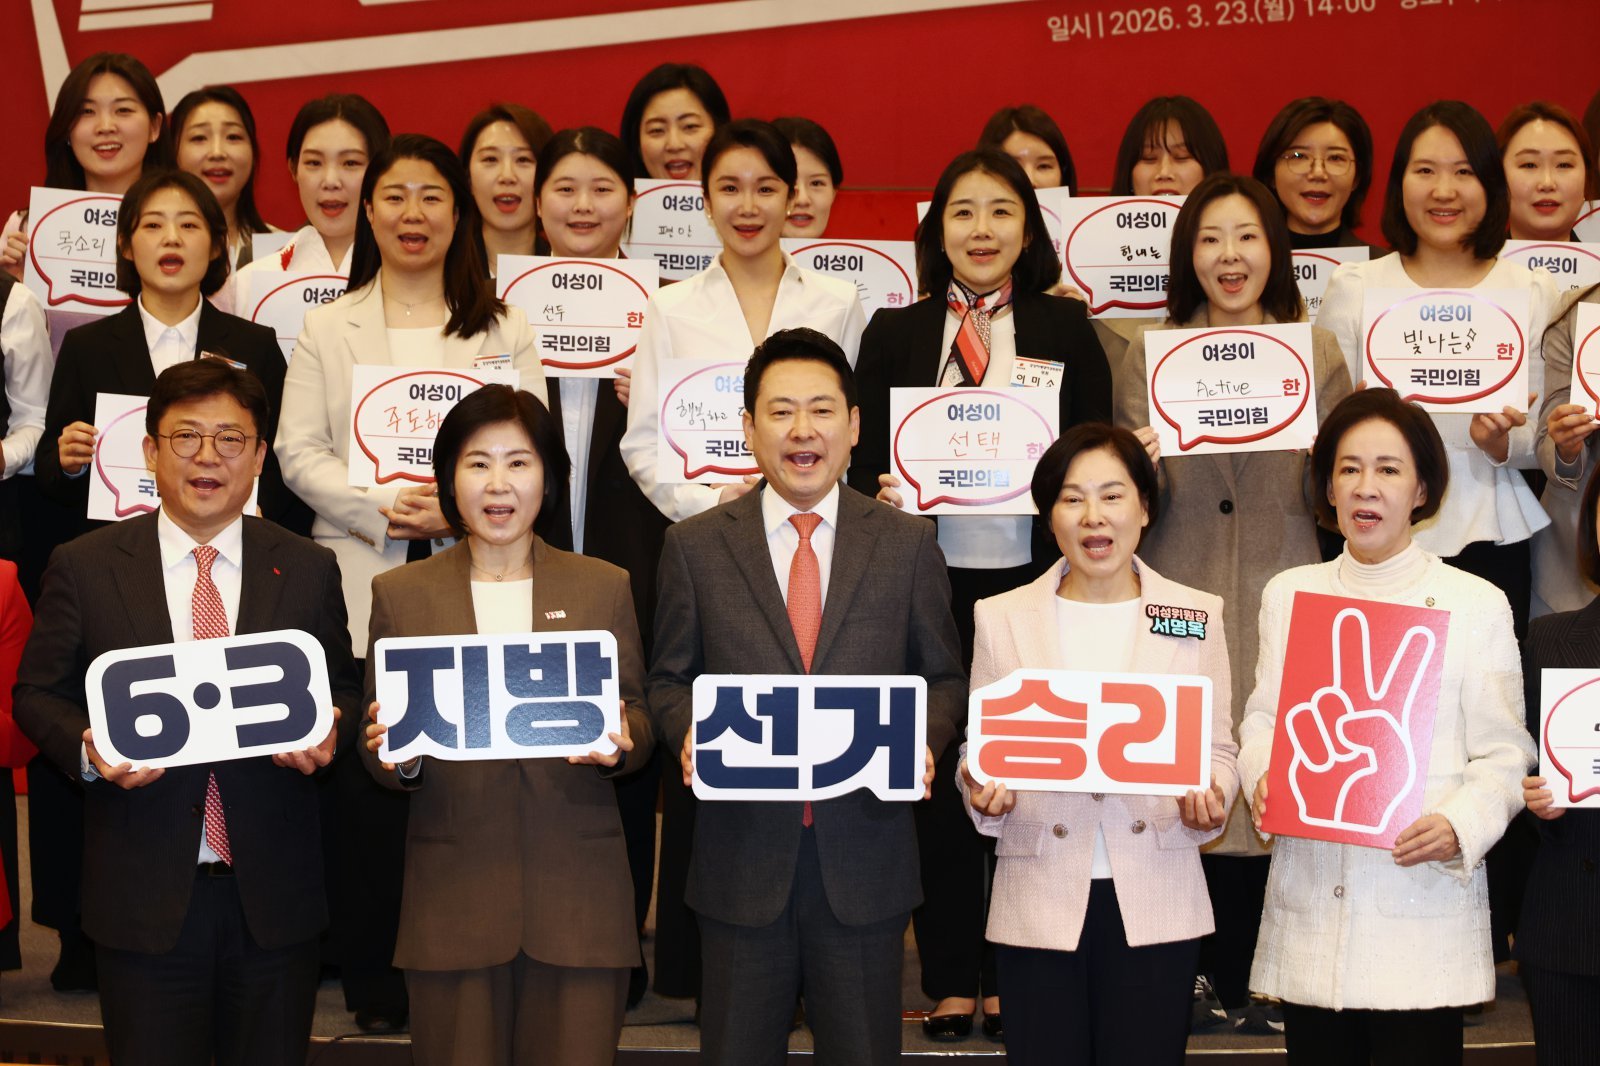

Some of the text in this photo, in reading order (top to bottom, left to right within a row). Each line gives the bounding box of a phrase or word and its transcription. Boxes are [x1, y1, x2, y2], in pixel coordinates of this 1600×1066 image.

[1047, 13, 1091, 42] 일시
[1109, 7, 1181, 35] 2026.
[1187, 4, 1210, 28] 3.
[84, 208, 117, 226] 여성
[1116, 212, 1166, 229] 여성이
[57, 231, 105, 257] 목소리
[1120, 245, 1162, 261] 힘내는
[813, 254, 863, 271] 여성이
[1528, 256, 1577, 274] 여성이
[552, 273, 602, 290] 여성이
[303, 288, 345, 304] 여성
[543, 304, 565, 322] 선두
[627, 311, 644, 328] 한
[1420, 304, 1472, 322] 여성이
[542, 334, 610, 352] 국민의힘
[1403, 329, 1463, 355] 빛나는
[1202, 342, 1255, 361] 여성이
[1496, 342, 1515, 361] 한
[714, 375, 744, 393] 여성
[1410, 369, 1480, 386] 국민의힘
[409, 383, 461, 401] 여성이
[1196, 379, 1252, 397] Active
[1282, 378, 1300, 396] 한
[384, 406, 445, 433] 주도하
[947, 403, 1000, 421] 여성이
[1198, 407, 1268, 427] 국민의힘
[948, 431, 1000, 458] 선택
[1026, 442, 1045, 460] 한
[397, 446, 432, 465] 국민
[938, 469, 1010, 487] 국민의힘
[1151, 617, 1205, 639] 서명옥
[384, 641, 612, 752] 지방
[695, 686, 917, 790] 선거
[978, 679, 1203, 786] 승리
